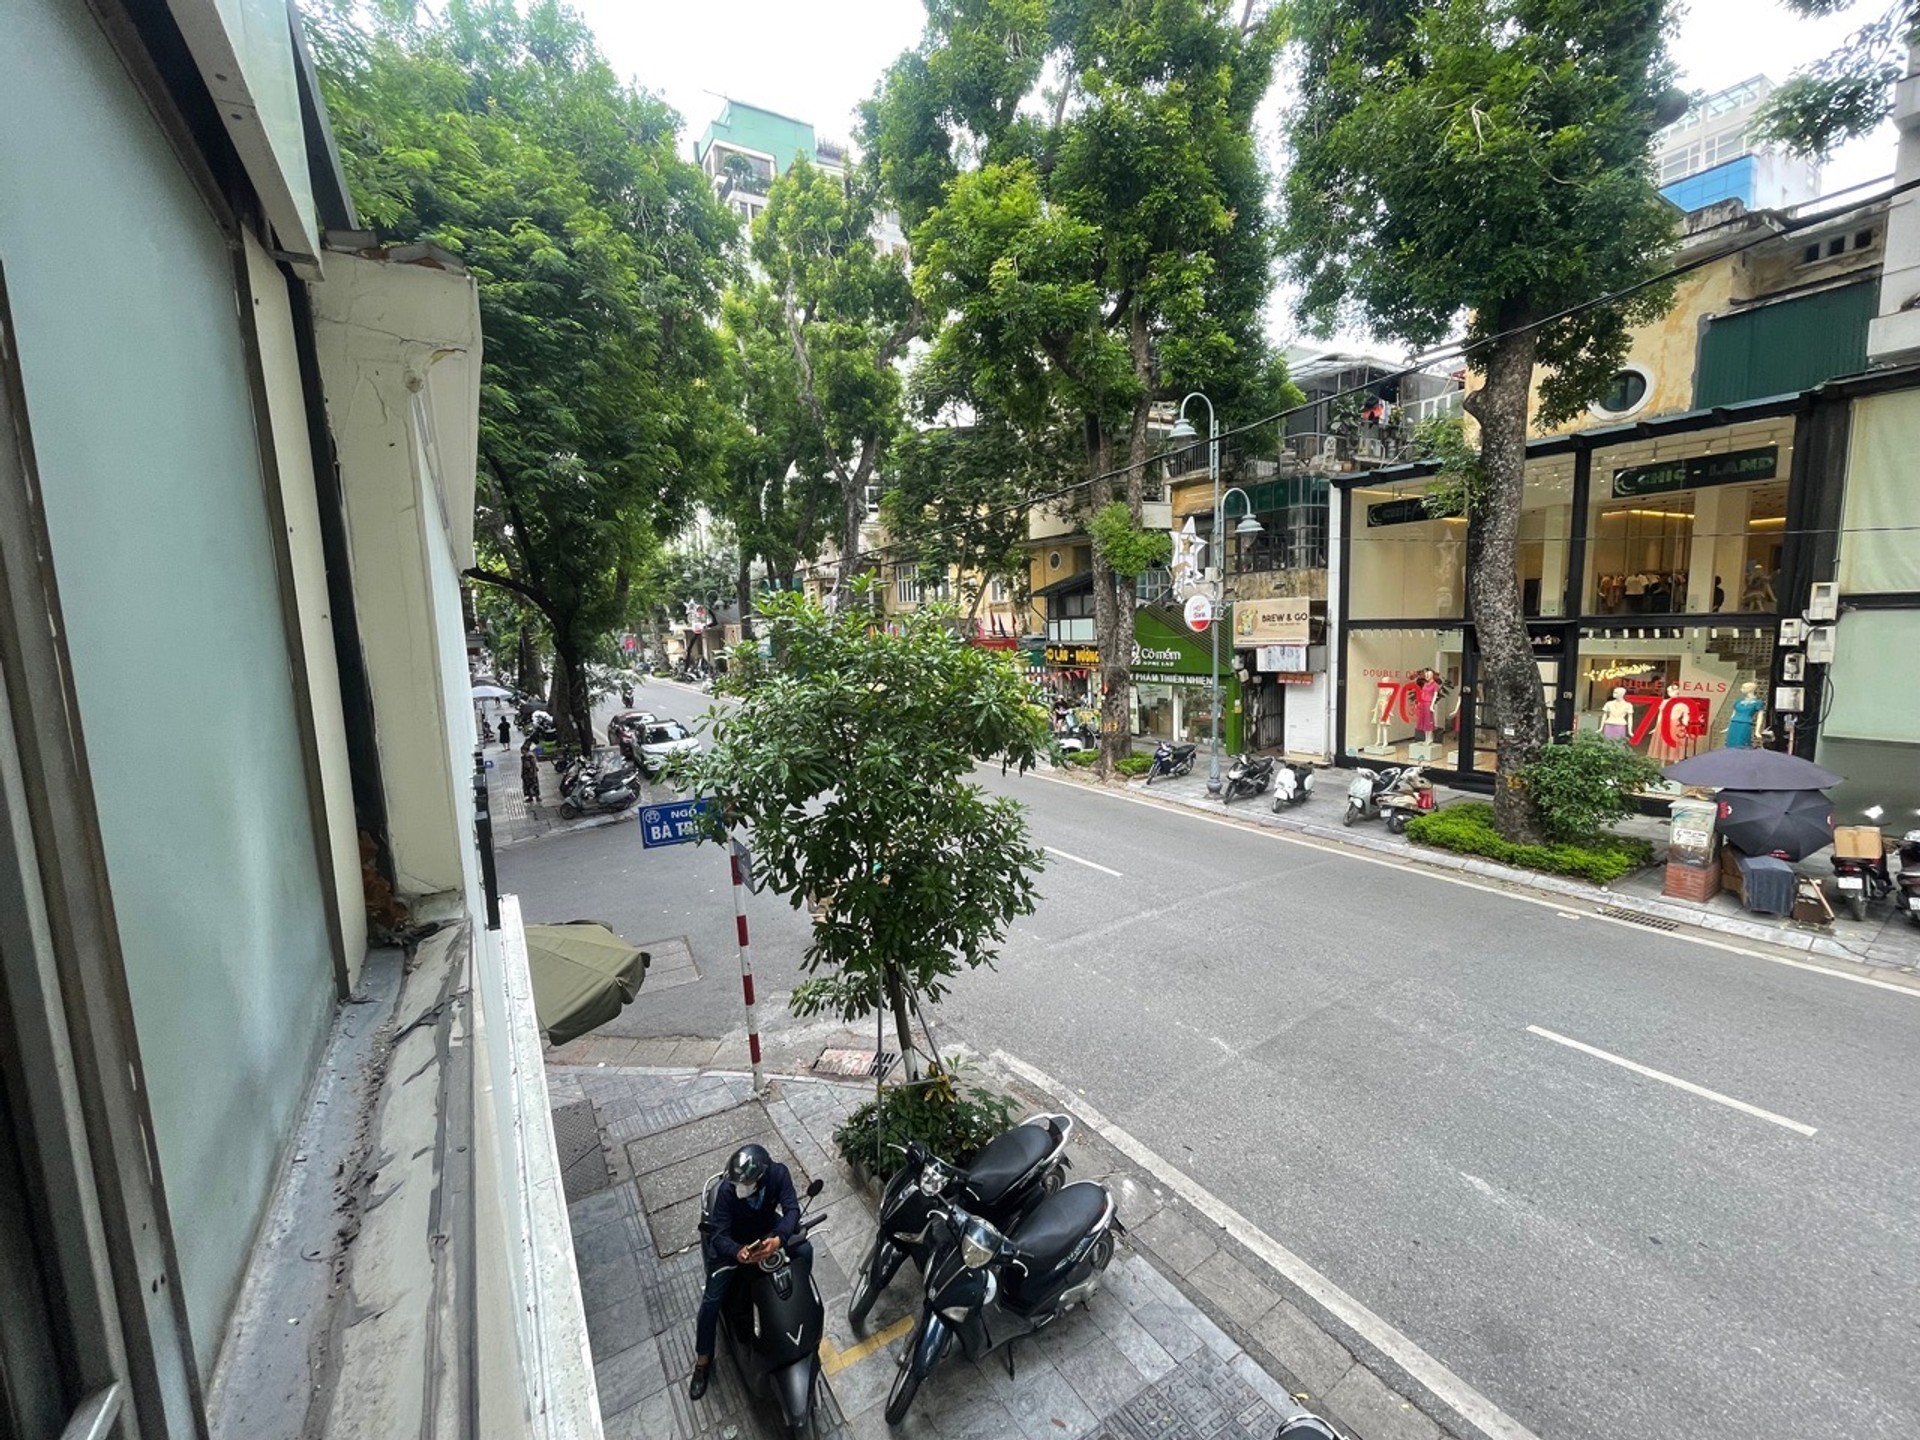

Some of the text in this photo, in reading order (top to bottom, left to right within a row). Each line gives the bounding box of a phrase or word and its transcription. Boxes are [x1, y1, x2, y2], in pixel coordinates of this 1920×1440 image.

[1637, 469, 1686, 486] CHIC
[1708, 456, 1775, 477] LAND
[1261, 612, 1308, 622] BREW & GO
[1363, 669, 1401, 678] DOUBLE
[651, 820, 673, 840] BÀ
